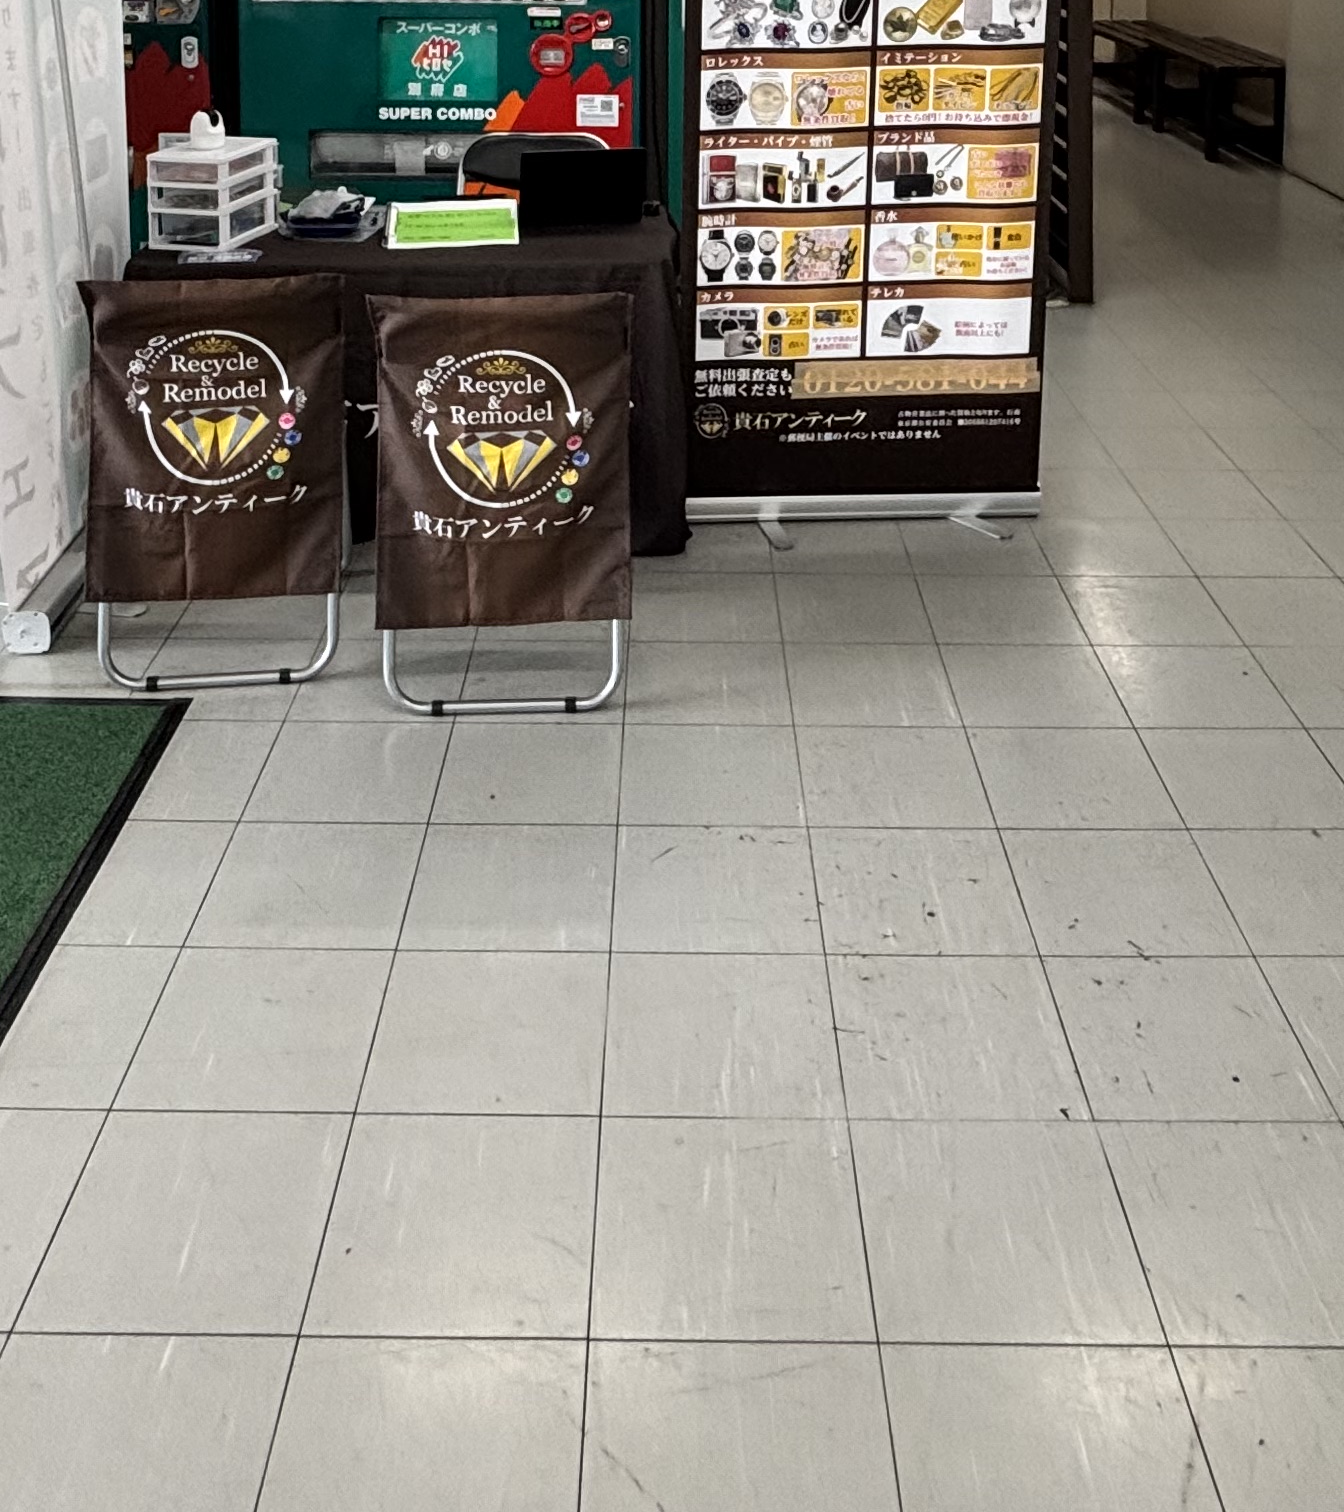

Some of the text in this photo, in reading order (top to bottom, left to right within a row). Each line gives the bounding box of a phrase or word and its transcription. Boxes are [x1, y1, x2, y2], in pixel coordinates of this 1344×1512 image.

[396, 21, 482, 35] スーパーコンボ
[428, 45, 448, 57] HI
[881, 51, 962, 64] イミテーション
[422, 58, 453, 71] ヒロセ
[706, 55, 764, 67] ロレックス
[379, 107, 497, 121] SUPER COMBO
[877, 131, 935, 143] ブランド品
[875, 211, 898, 223] 香水
[701, 291, 733, 302] カメラ
[870, 287, 904, 298] テレカ
[170, 352, 259, 376] Recycle
[201, 375, 214, 388] &
[694, 368, 792, 382] 無料出張査定も
[163, 379, 267, 403] Remodel
[458, 374, 546, 397] Recycle
[694, 383, 792, 398] ご依頼ください
[488, 397, 502, 410] &
[450, 401, 553, 426] Remodel
[733, 409, 867, 431] 貴石アンティーク
[124, 484, 308, 516] 貴石アンティーク
[412, 505, 595, 540] 貴石アンティーク
